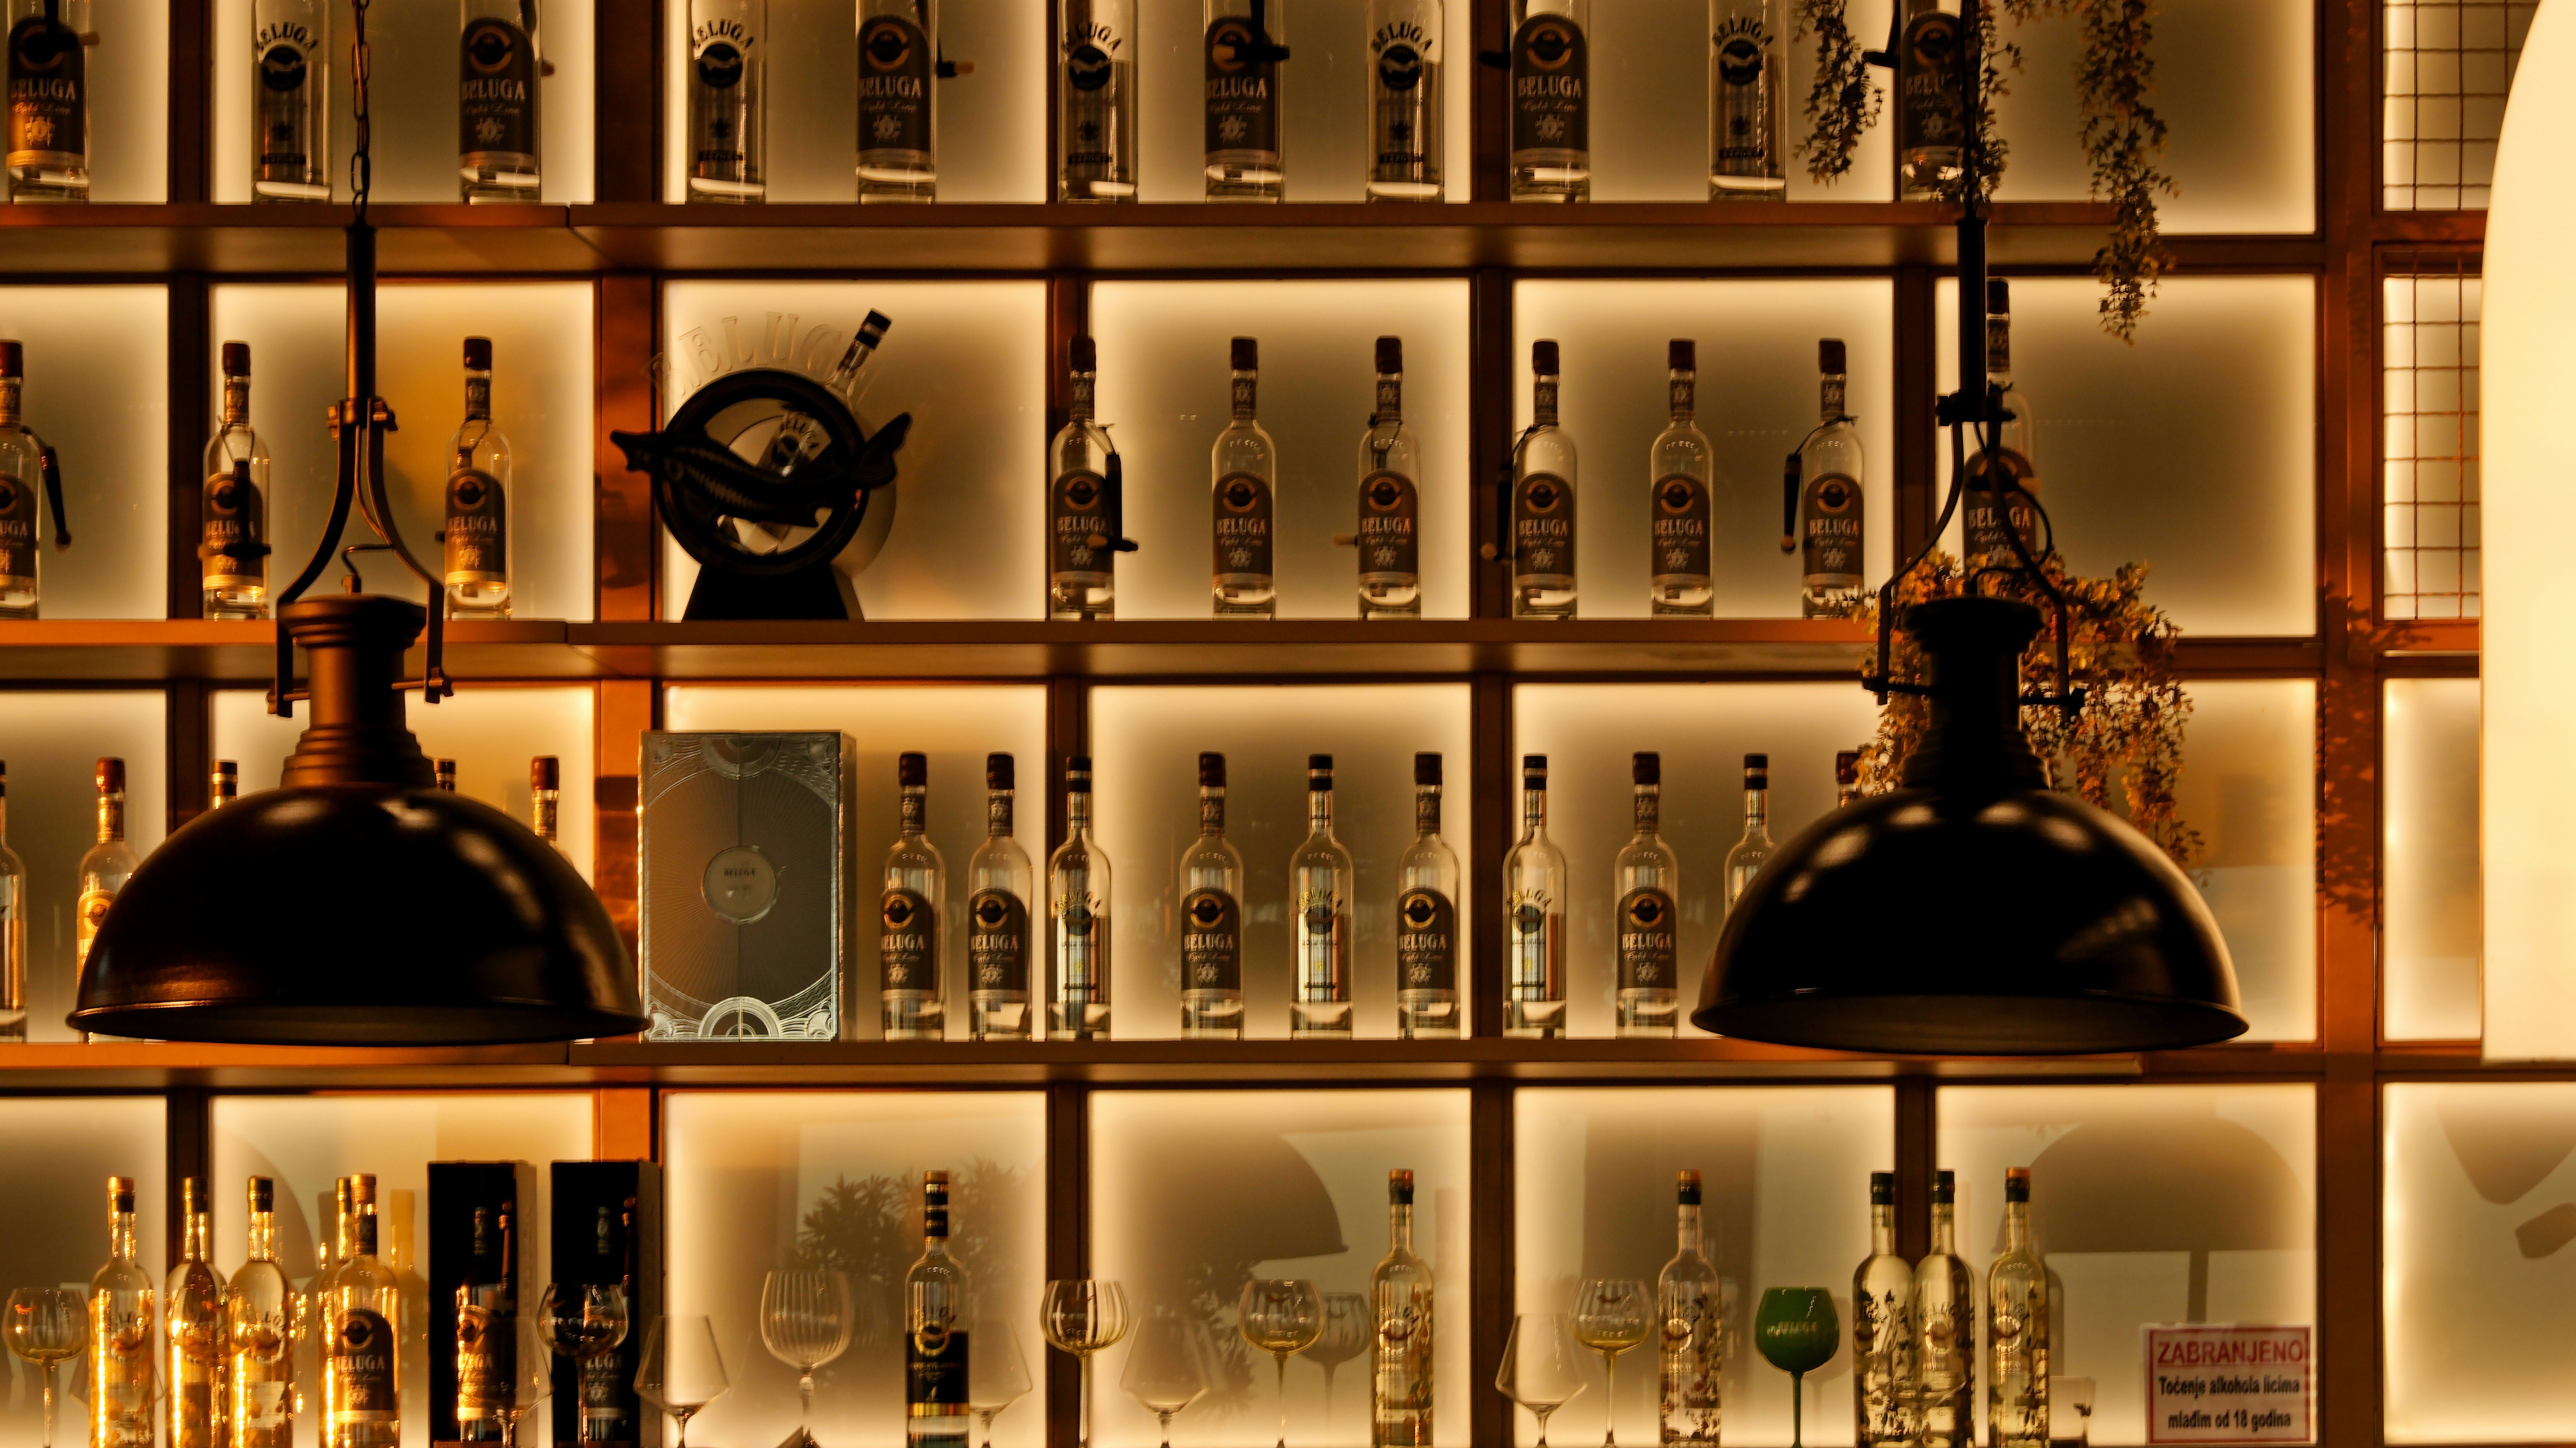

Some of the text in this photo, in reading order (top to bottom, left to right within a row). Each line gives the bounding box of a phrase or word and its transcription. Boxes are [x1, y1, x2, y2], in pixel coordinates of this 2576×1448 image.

[255, 22, 319, 52] BELUGA
[692, 19, 753, 49] BELUGA
[1063, 22, 1122, 52] LUGA
[1371, 21, 1433, 52] BELUGA
[1712, 18, 1774, 47] BELUGA
[10, 79, 76, 102] BELUGA
[461, 79, 525, 102] BELUGA
[859, 77, 922, 98] BELUGA
[1206, 77, 1268, 99] BELUGA
[1518, 75, 1581, 98] BELUGA
[1906, 75, 1964, 97] BELU
[448, 516, 498, 532] BELUGA
[1217, 518, 1266, 535] BELUGA
[1362, 518, 1412, 535] BELUGA
[1519, 519, 1568, 536] BELUGA
[1655, 519, 1703, 536] BELUGA
[1809, 519, 1859, 537] BELUGA
[1969, 507, 2031, 528] BELGA
[971, 934, 1018, 952] BELUGA
[1184, 934, 1233, 952] BELUGA
[1399, 934, 1447, 952] BELUGA
[1622, 933, 1672, 951] BELUGA
[2158, 1339, 2303, 1364] ZABRANJENO
[2209, 1375, 2259, 1394] alkohola
[2264, 1375, 2299, 1394] licima
[2216, 1410, 2229, 1428] od
[2234, 1409, 2247, 1428] 18
[2251, 1408, 2291, 1432] godina
